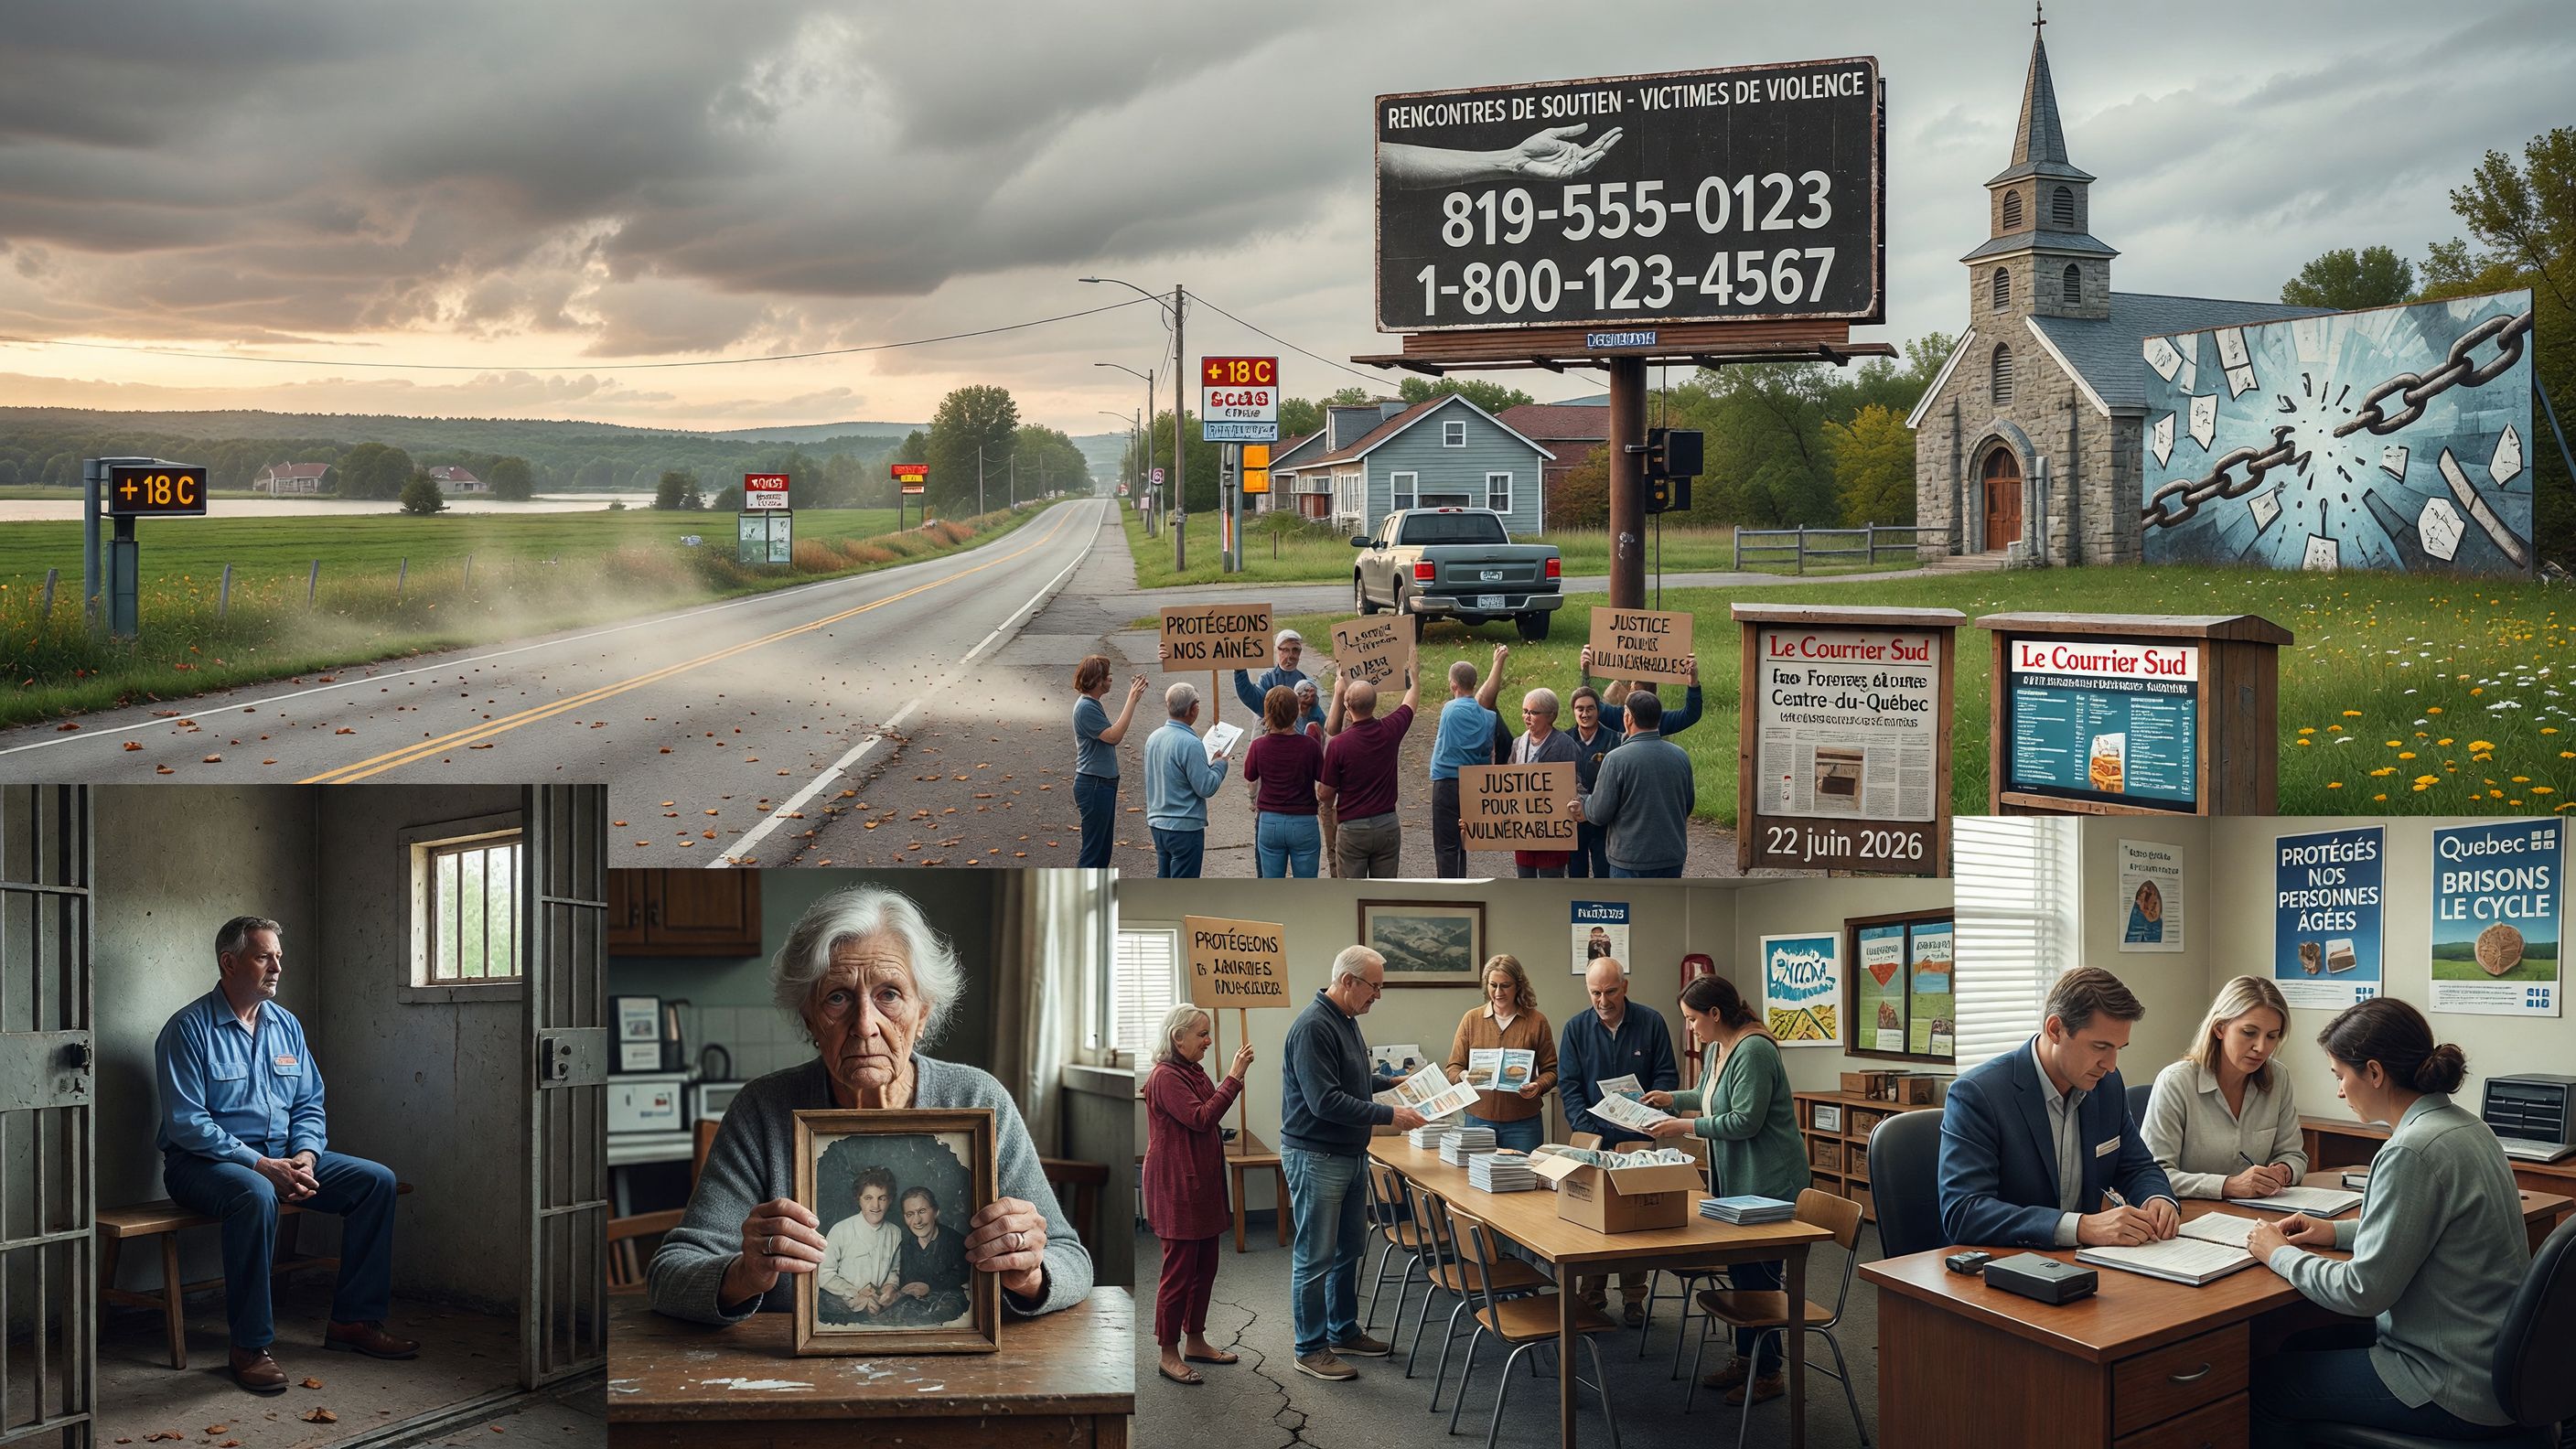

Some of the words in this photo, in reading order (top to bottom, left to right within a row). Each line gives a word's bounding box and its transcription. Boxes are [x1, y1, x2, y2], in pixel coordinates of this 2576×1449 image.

[1388, 101, 1506, 129] RENCONTRES
[1512, 97, 1536, 121] DE
[1540, 91, 1622, 118] SOUTIEN
[1640, 81, 1729, 111] VICTIMES
[1735, 80, 1760, 104] DE
[1766, 71, 1864, 101] VIOLENCE
[1442, 170, 1832, 248] 819-555-0123
[1416, 247, 1835, 317] 1-800-123-4567
[1166, 610, 1269, 635] PROTÉGEONS
[1610, 615, 1670, 634] JUSTICE
[1174, 641, 1207, 659] NOS
[1770, 635, 1796, 657] Le
[1800, 636, 1885, 660] Courrier
[1891, 639, 1929, 661] Sud
[2022, 645, 2045, 668] Le
[2052, 646, 2139, 672] Courrier
[2144, 649, 2186, 675] Sud
[1479, 772, 1553, 794] JUSTICE
[1482, 799, 1519, 815] POUR
[1526, 798, 1553, 814] LES
[1766, 827, 1798, 854] 22
[1804, 827, 1852, 863] juin
[1859, 830, 1923, 860] 2026
[2281, 837, 2377, 866] PROTÉGÉS
[2440, 832, 2526, 863] Quebec
[2308, 867, 2345, 887] NOS
[2442, 865, 2550, 895] BRISONS
[2279, 886, 2378, 908] PERSONNES
[2441, 897, 2467, 920] LE
[2473, 894, 2550, 919] CYCLE
[2297, 907, 2356, 932] ÂGÉES
